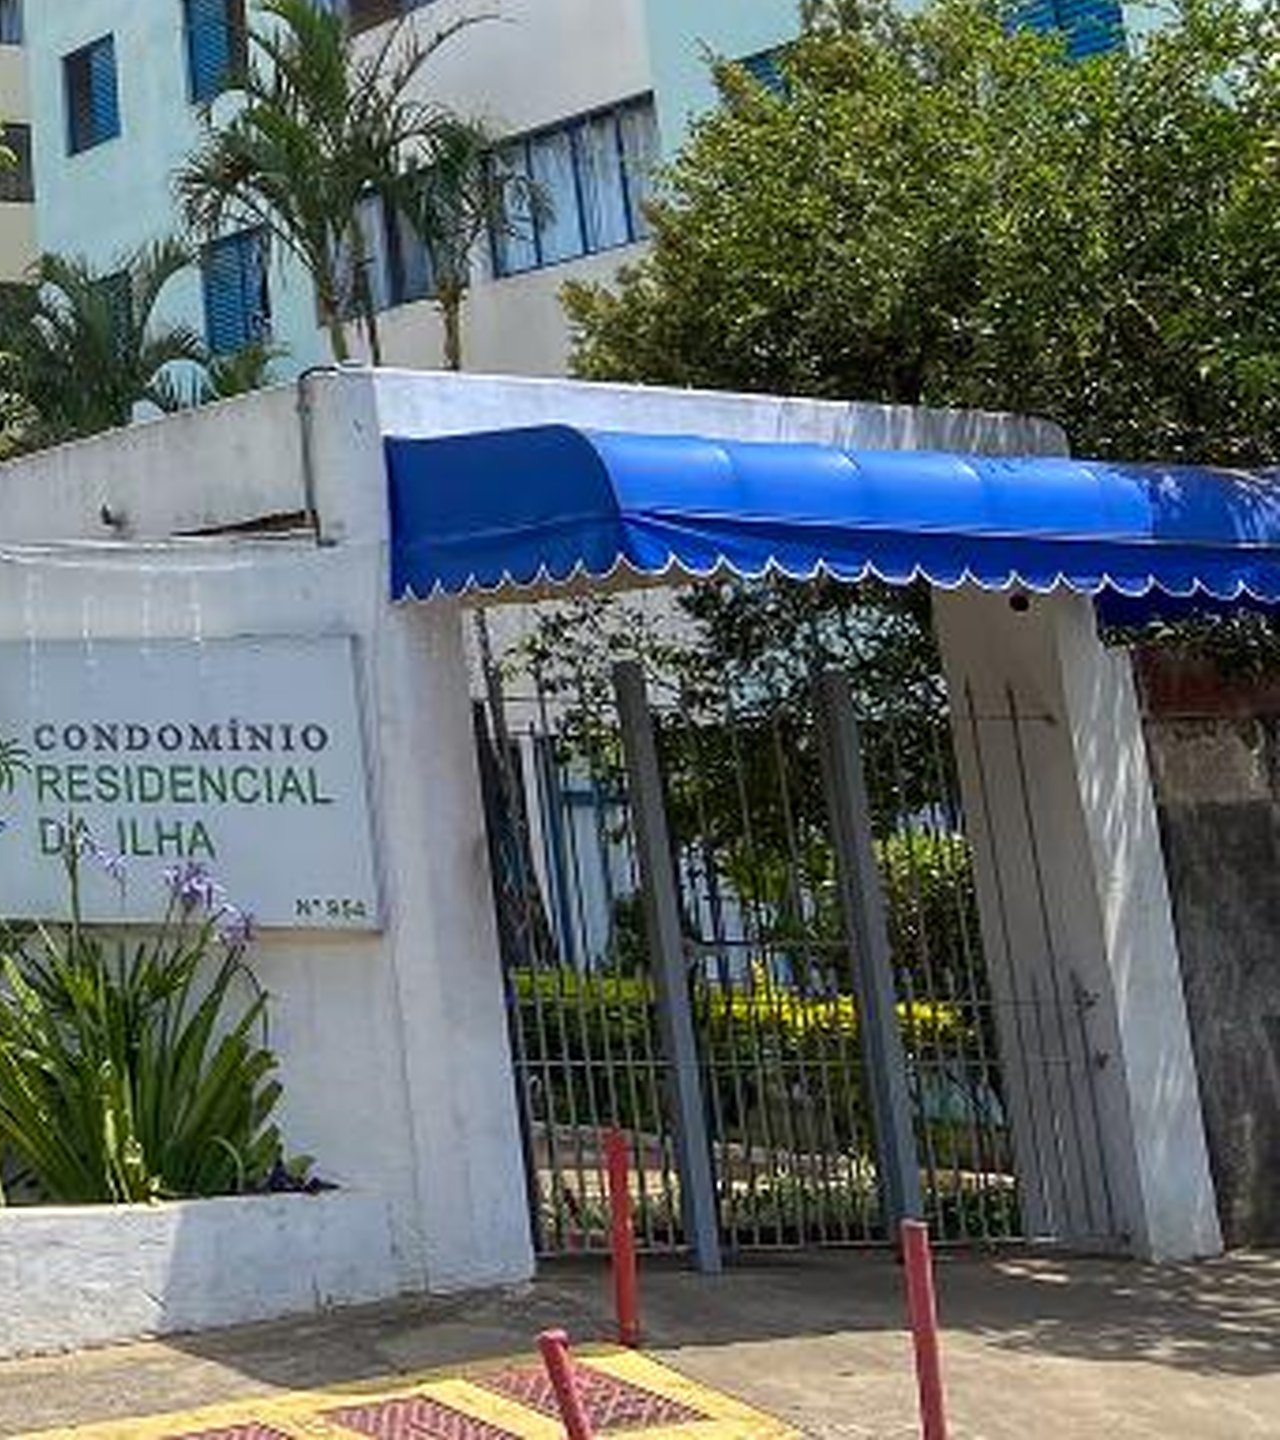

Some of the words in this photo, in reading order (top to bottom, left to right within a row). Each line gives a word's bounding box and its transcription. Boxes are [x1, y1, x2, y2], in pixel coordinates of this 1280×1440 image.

[33, 717, 330, 753] CONDOMÍNIO
[37, 763, 337, 805] RESIDENCIAL
[39, 816, 98, 855] DA
[116, 816, 217, 859] ILHA
